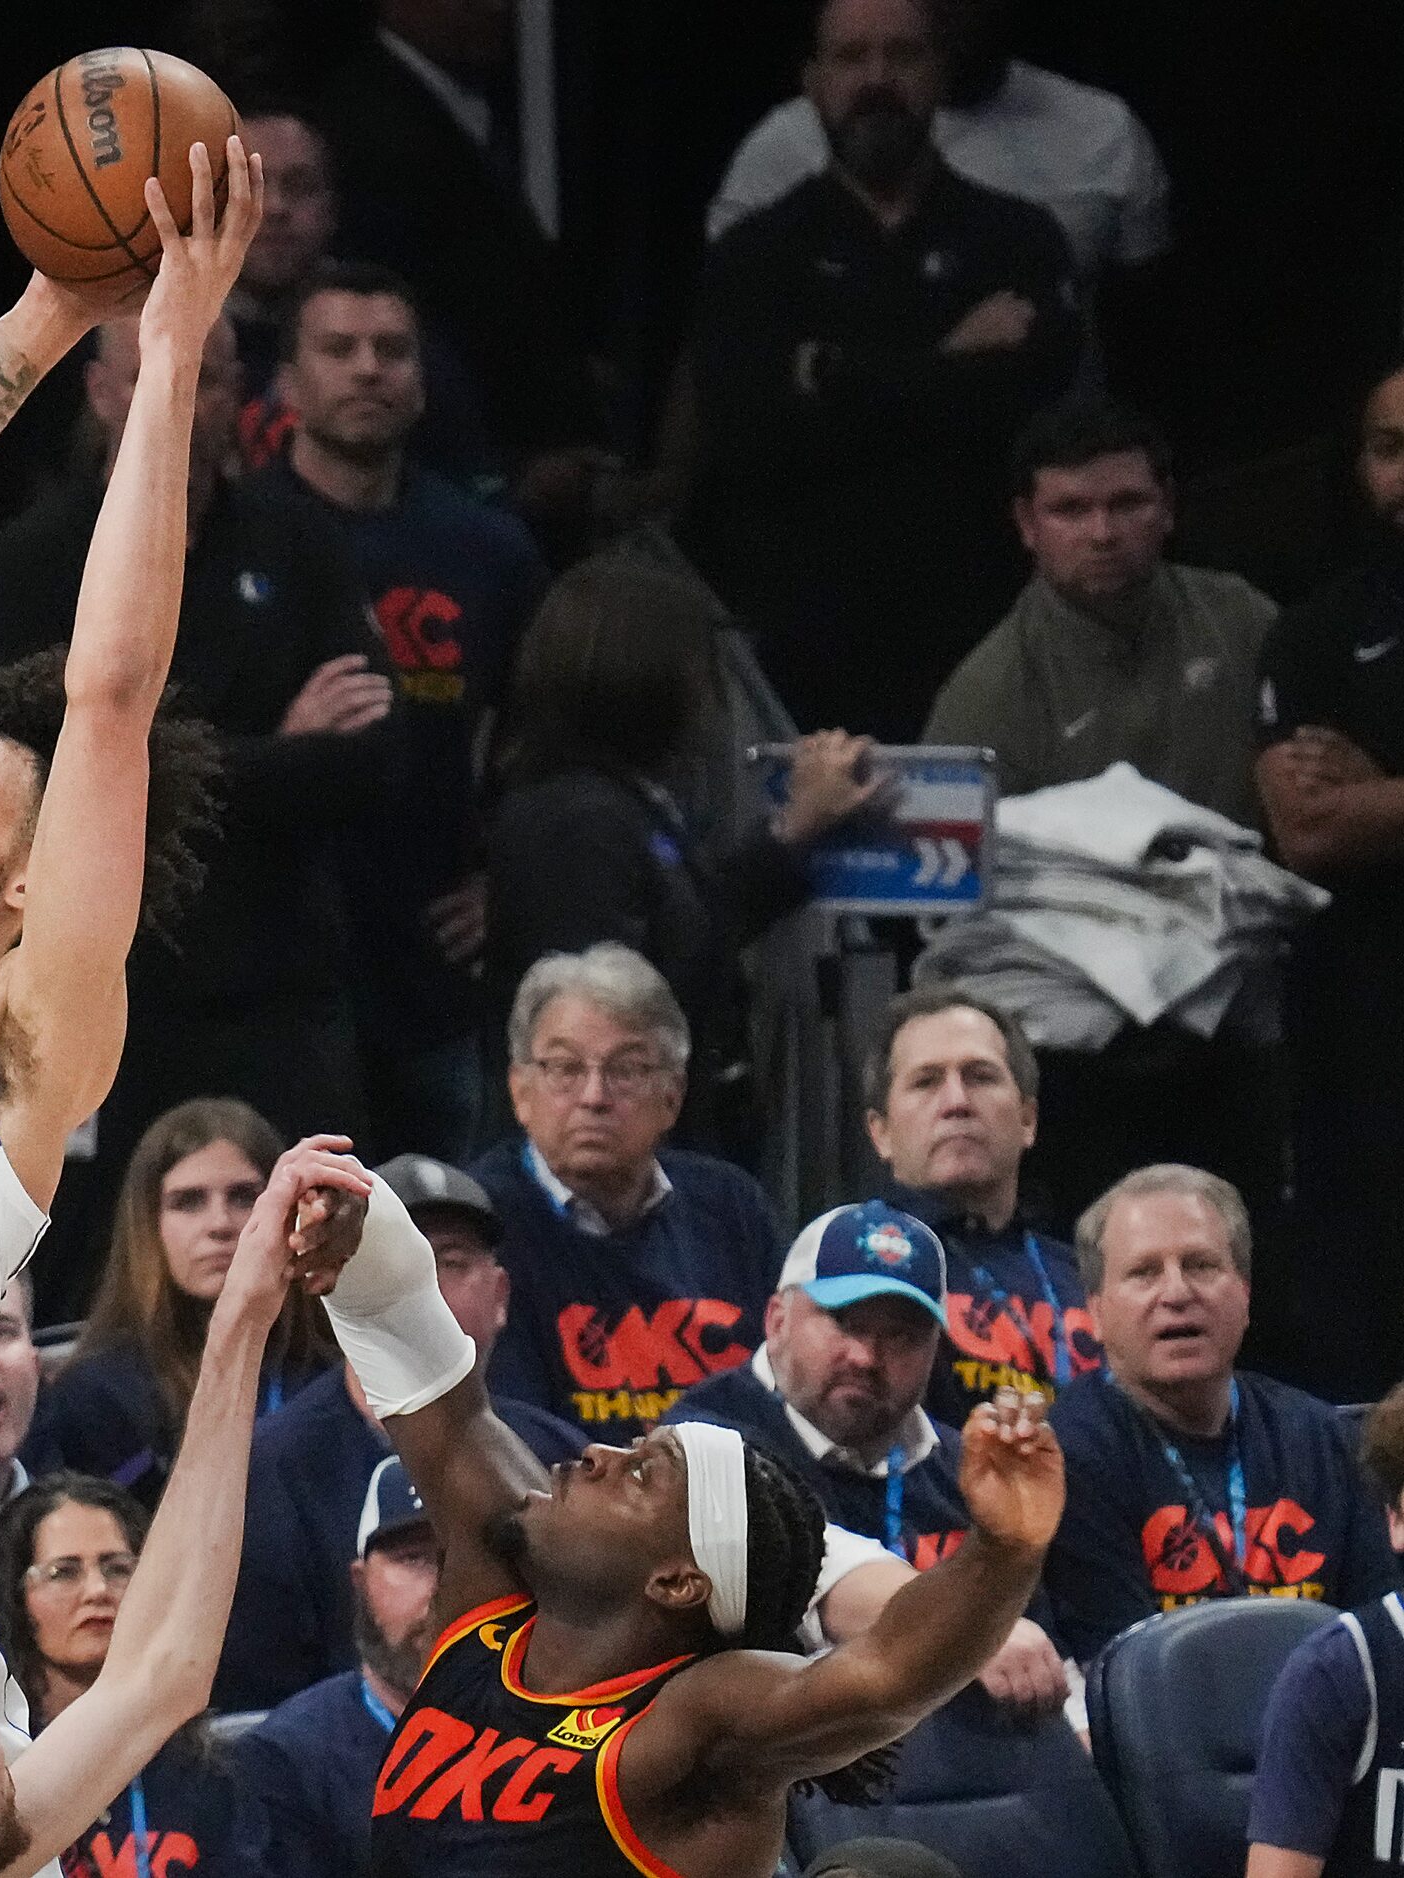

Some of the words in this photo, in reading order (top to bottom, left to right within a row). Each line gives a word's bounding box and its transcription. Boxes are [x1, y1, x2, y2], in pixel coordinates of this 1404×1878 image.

[558, 1299, 753, 1390] OKC
[1140, 1497, 1327, 1596] OKC
[371, 1706, 584, 1823] OKC
